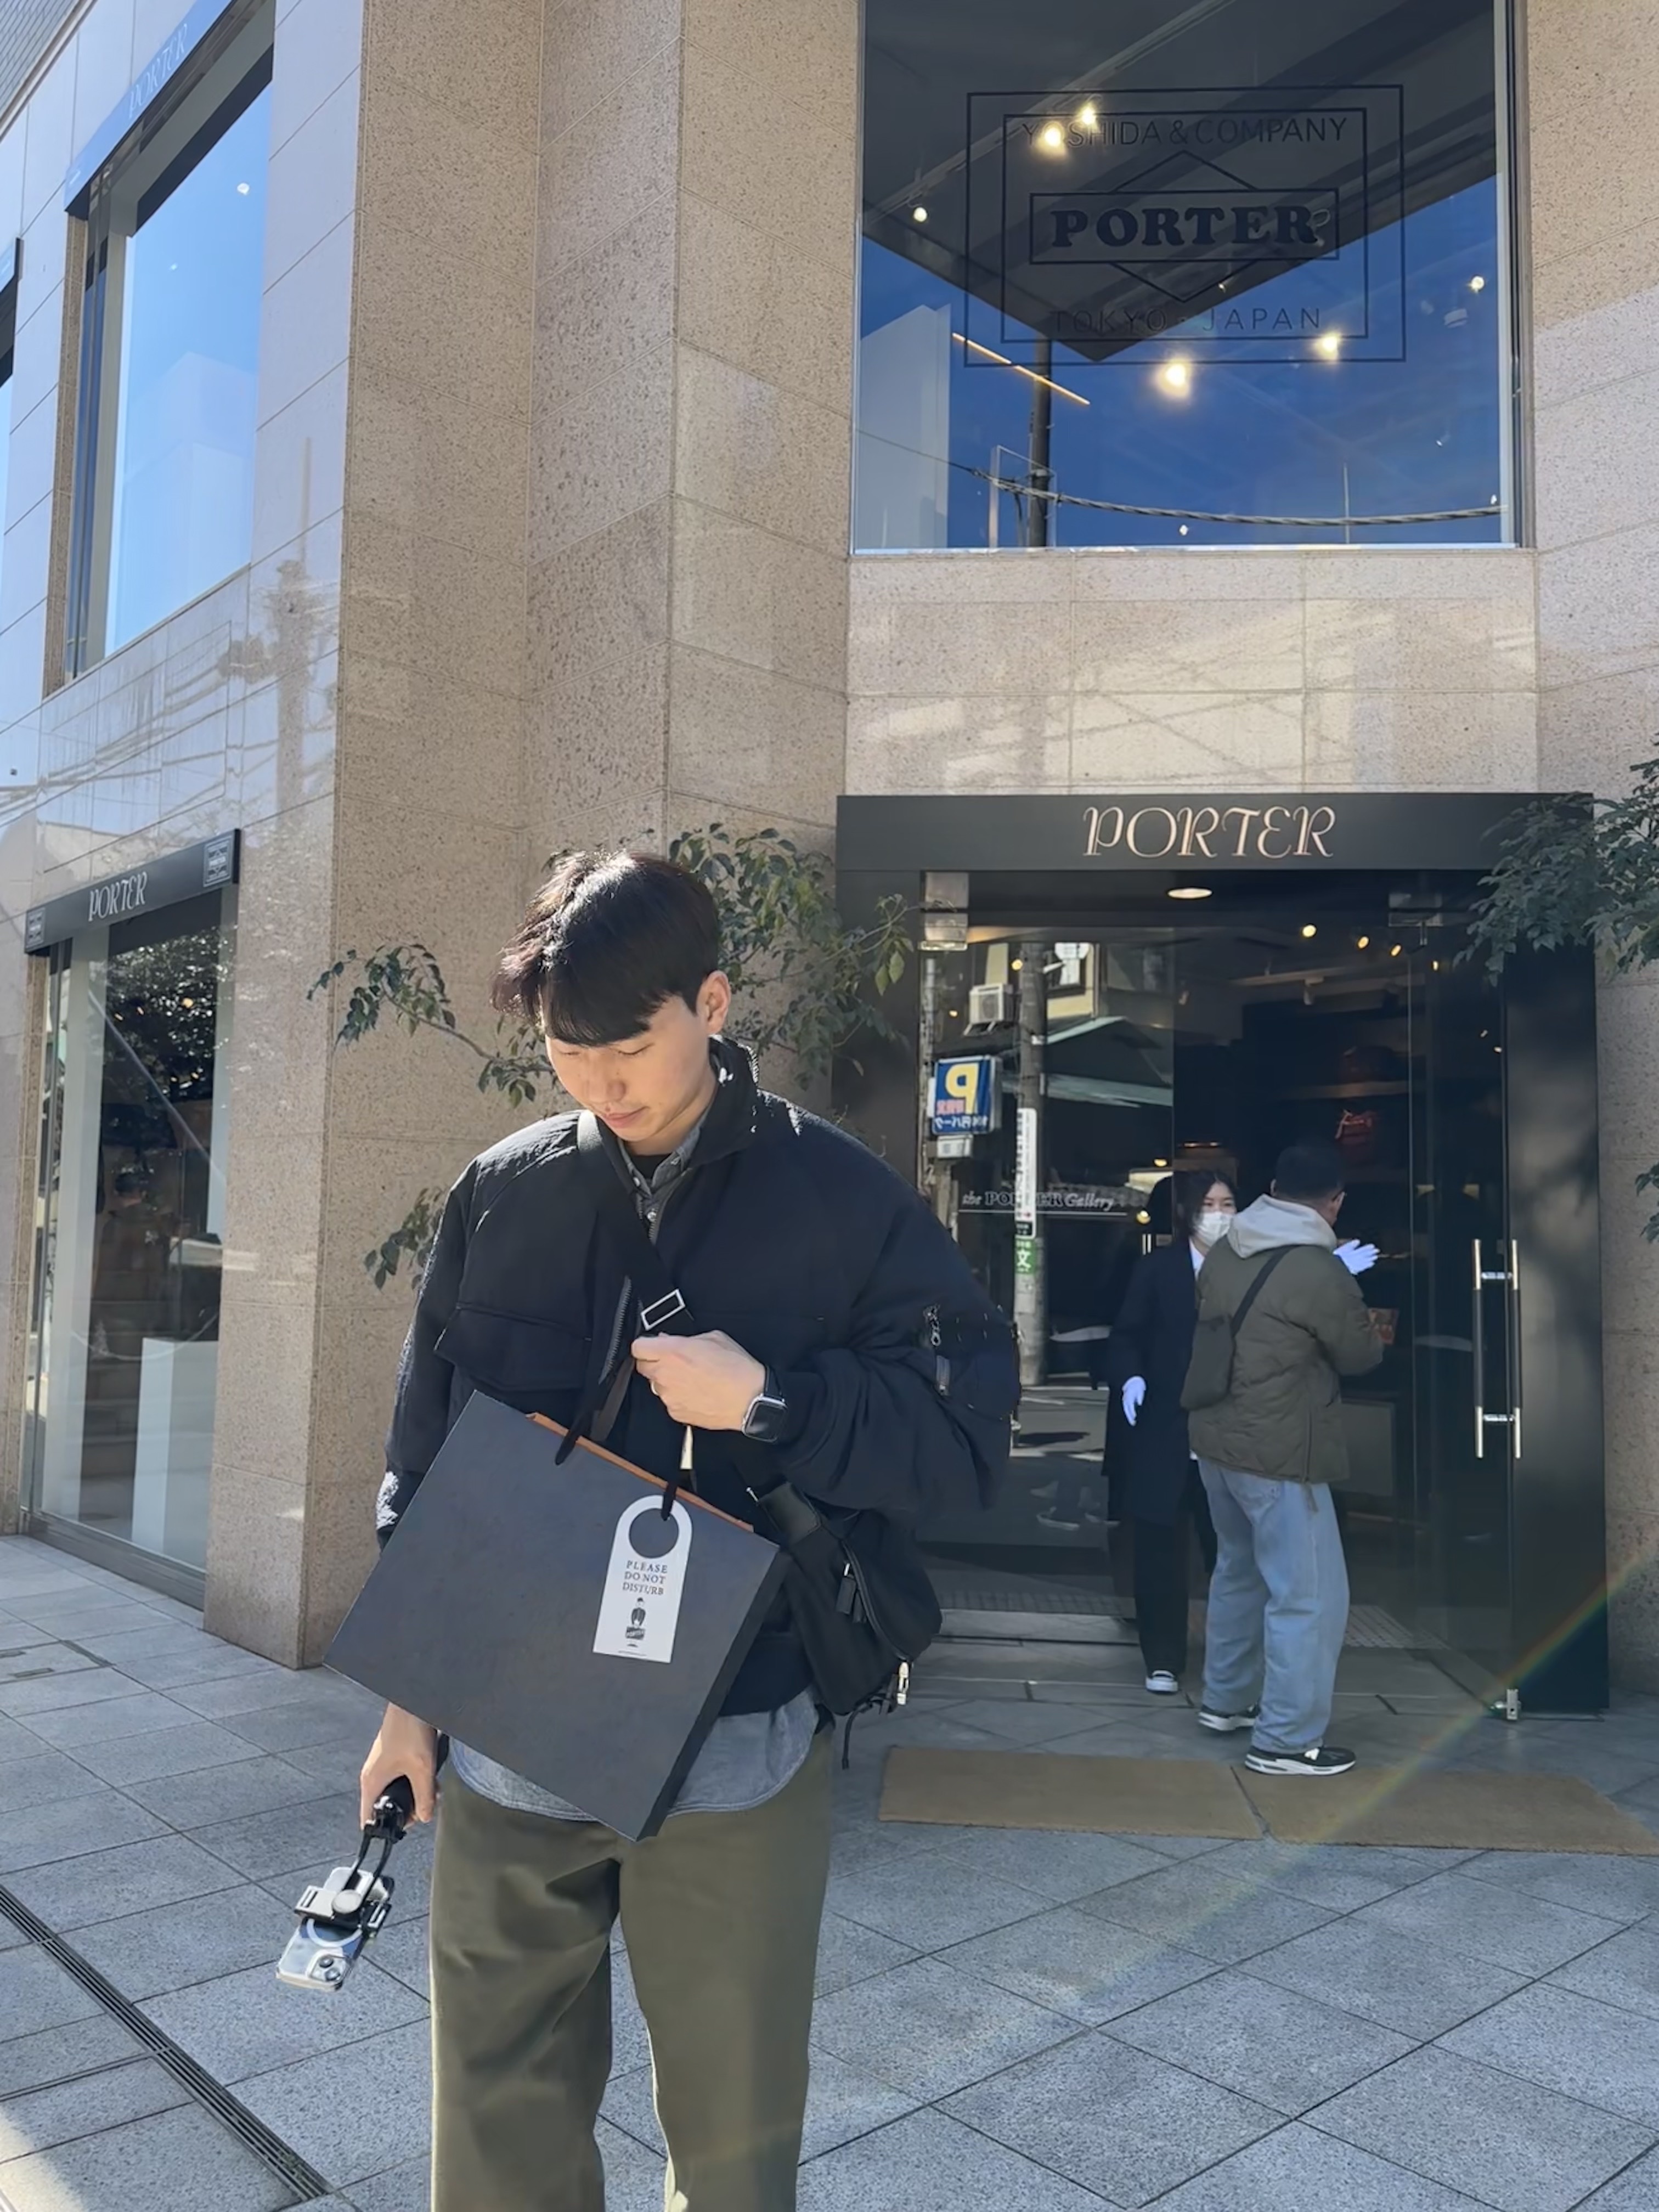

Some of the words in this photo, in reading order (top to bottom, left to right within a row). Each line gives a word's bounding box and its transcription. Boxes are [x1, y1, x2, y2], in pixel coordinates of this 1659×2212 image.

[1022, 120, 1161, 147] YSHIDA
[1170, 119, 1188, 145] &
[1195, 117, 1347, 145] COMPANY
[1049, 205, 1319, 247] PORTER
[1049, 308, 1167, 332] TOKYO
[1202, 307, 1321, 332] JAPAN
[1082, 805, 1336, 859] PORTER
[87, 871, 148, 922] PORTER
[985, 1191, 1065, 1207] POER
[1065, 1193, 1115, 1212] Gallery
[624, 1571, 640, 1581] DO
[642, 1573, 667, 1584] NOT
[626, 1560, 668, 1573] PLEASE
[622, 1582, 664, 1595] DISTURB
